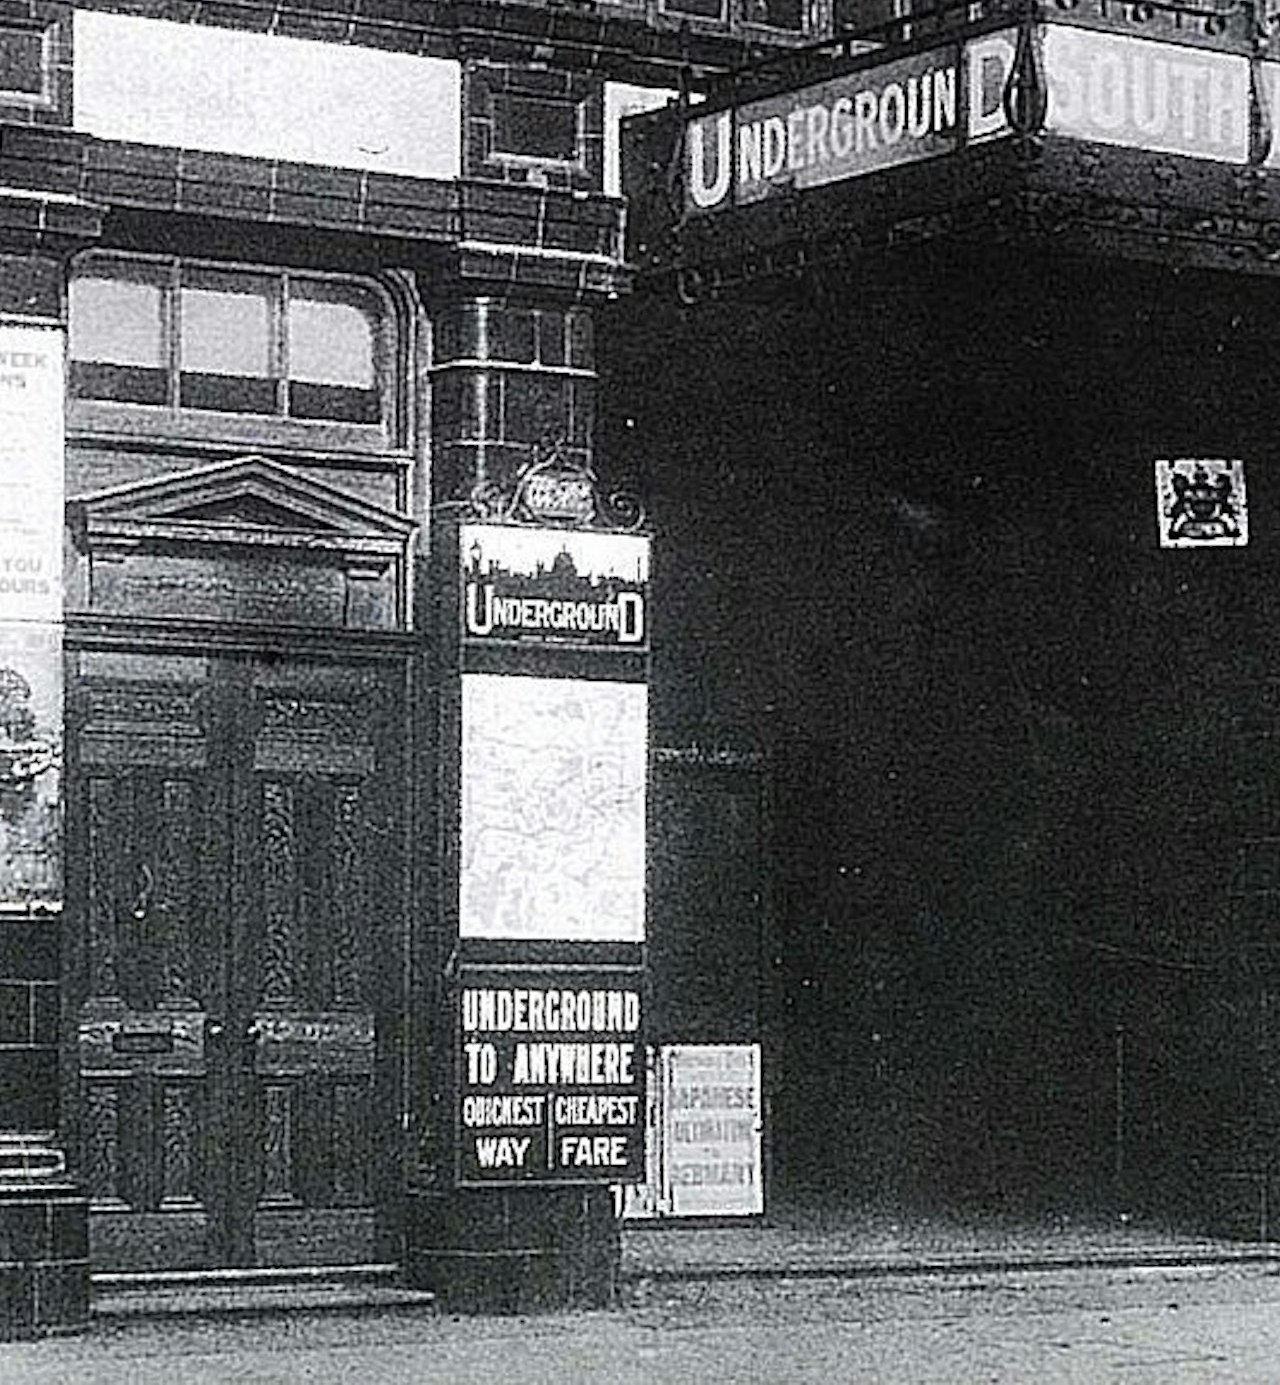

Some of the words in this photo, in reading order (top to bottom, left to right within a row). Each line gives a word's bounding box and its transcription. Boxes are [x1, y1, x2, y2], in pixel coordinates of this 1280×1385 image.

[1048, 49, 1248, 147] SOUTH
[689, 36, 1017, 209] UNDERGROUND
[2, 556, 43, 573] YOU
[467, 582, 644, 643] UNDERGROUND
[463, 989, 640, 1032] UNDERGROUND
[464, 1042, 497, 1085] TO
[512, 1042, 635, 1085] ANYWHERE
[463, 1095, 546, 1126] QUICKEST
[555, 1095, 639, 1126] CHEAPEST
[475, 1136, 531, 1168] WAY
[561, 1136, 628, 1167] FARE
